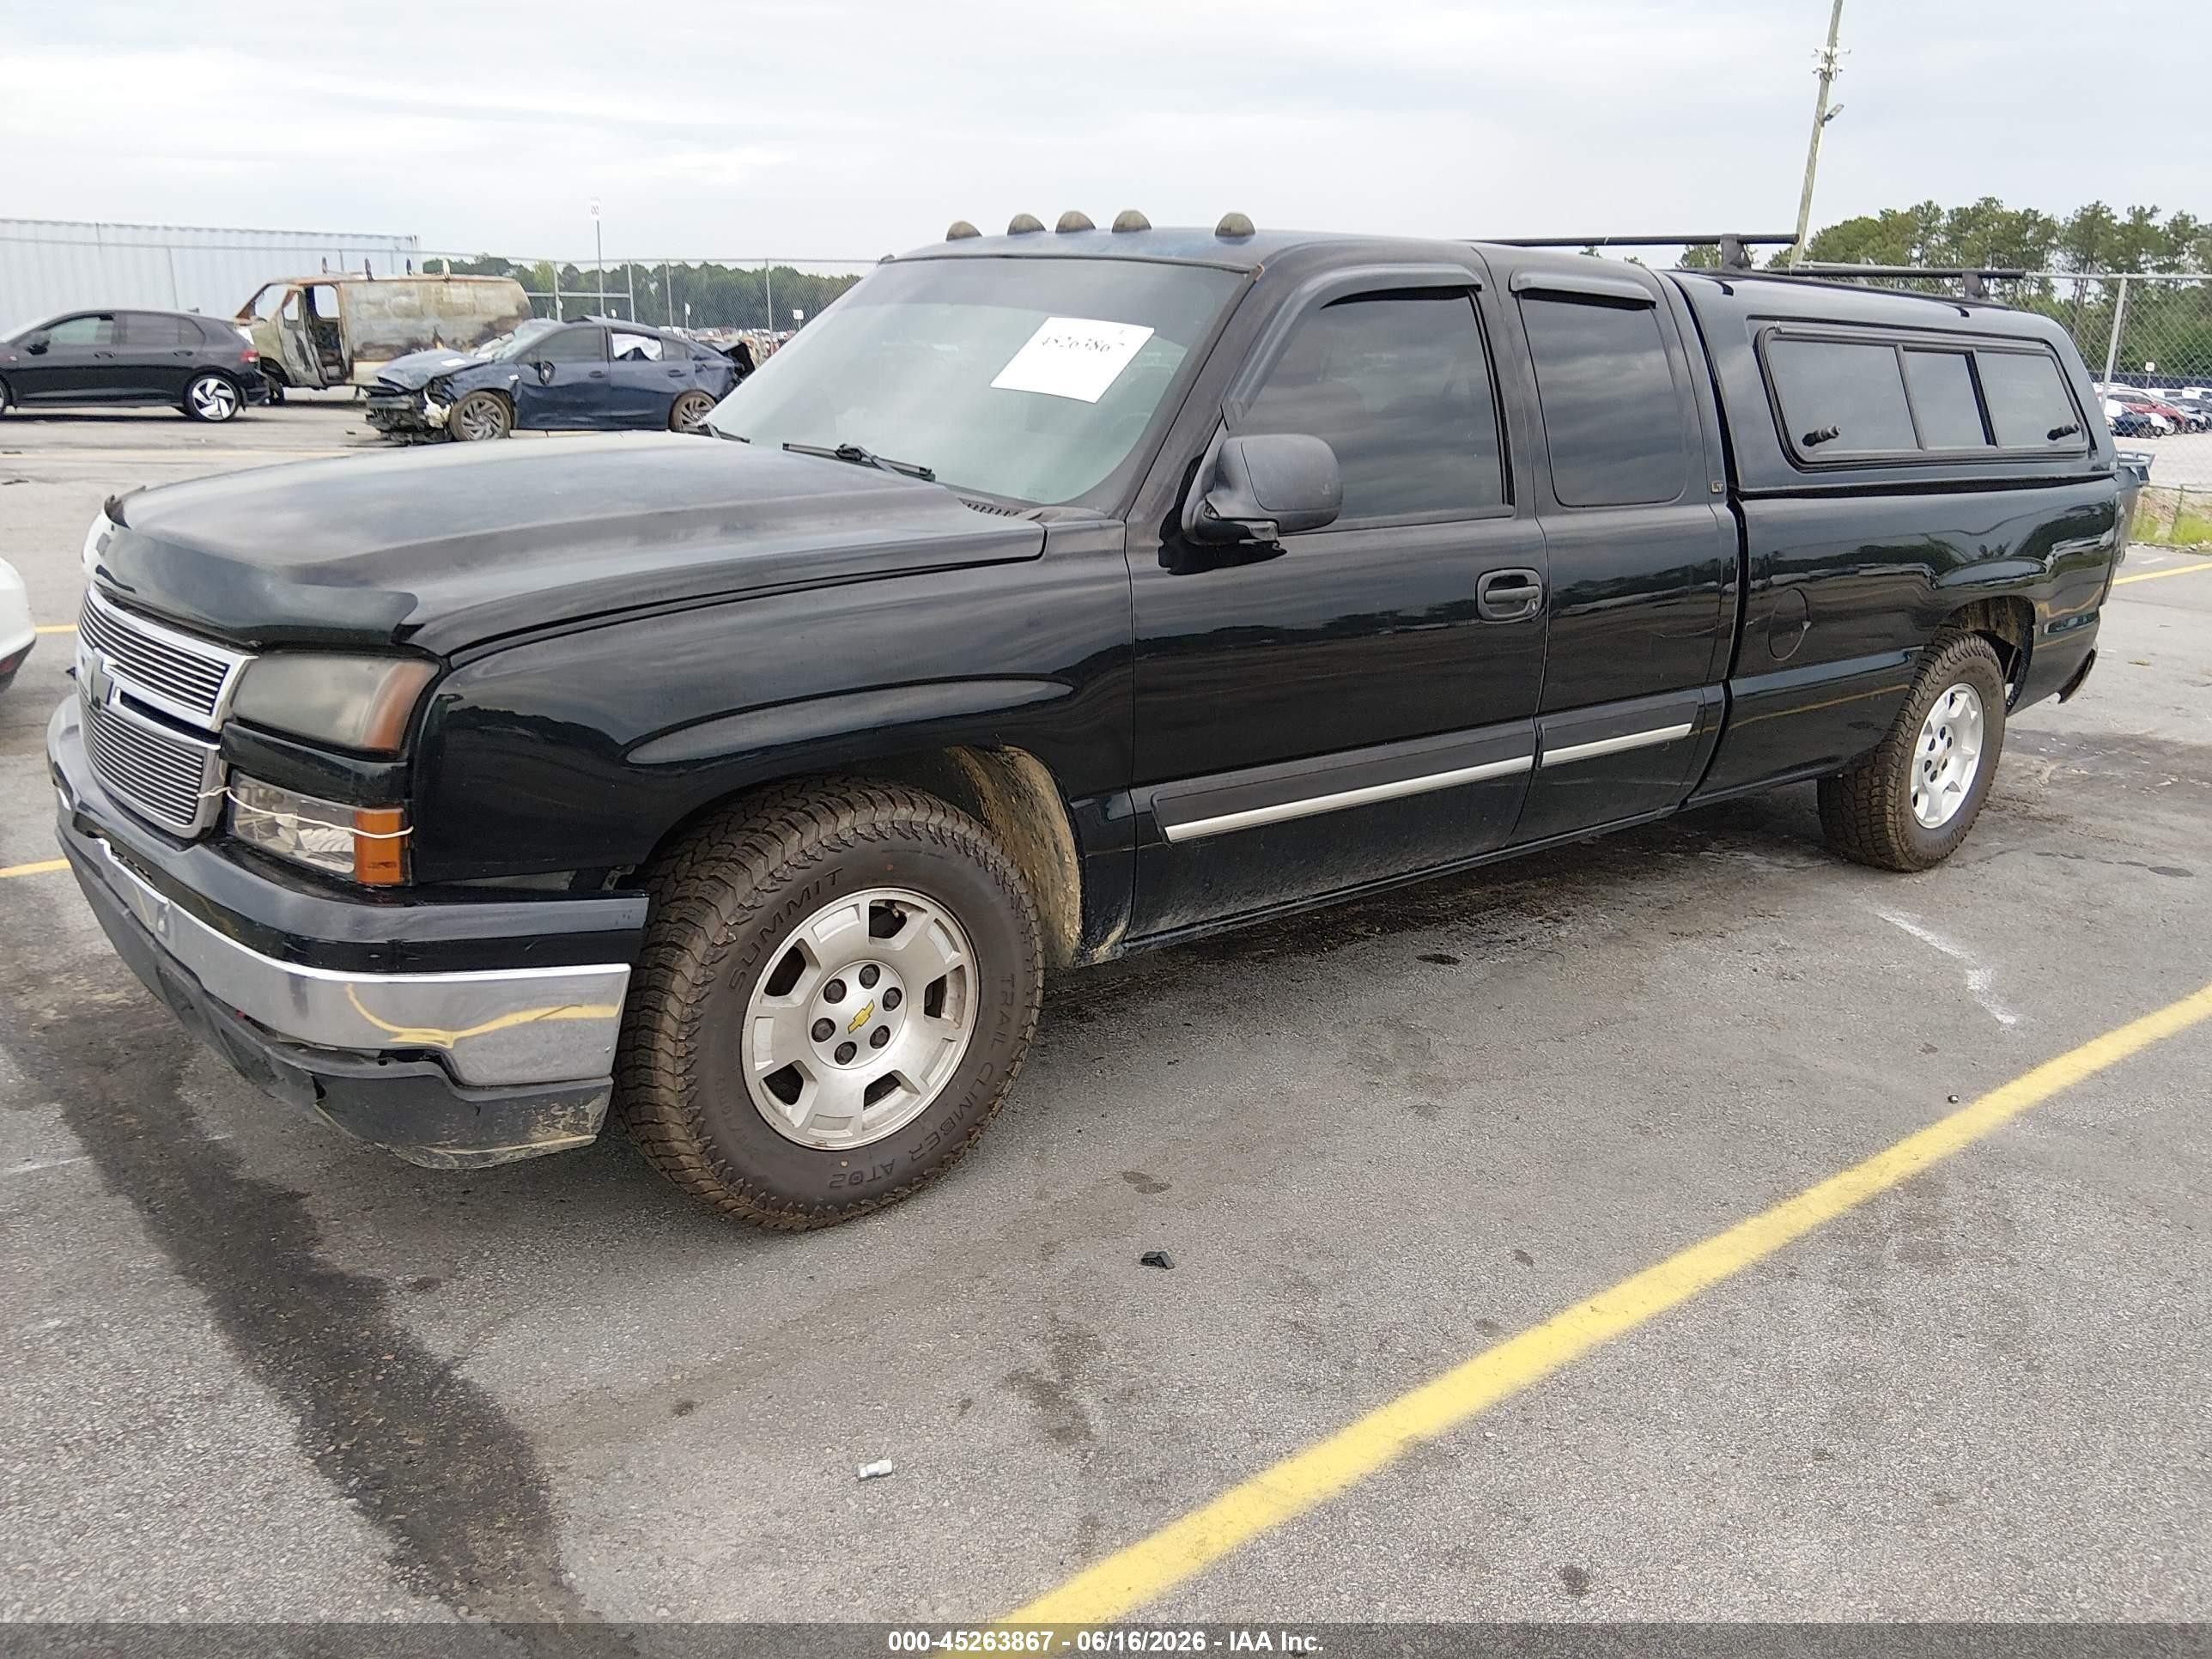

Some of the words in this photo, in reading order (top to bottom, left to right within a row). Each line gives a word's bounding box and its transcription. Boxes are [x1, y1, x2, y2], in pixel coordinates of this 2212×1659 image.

[1711, 482, 1724, 493] LT
[729, 866, 843, 993] SUMMIT
[991, 973, 1016, 1051] TRAIL
[908, 1060, 994, 1163] CLIMBER
